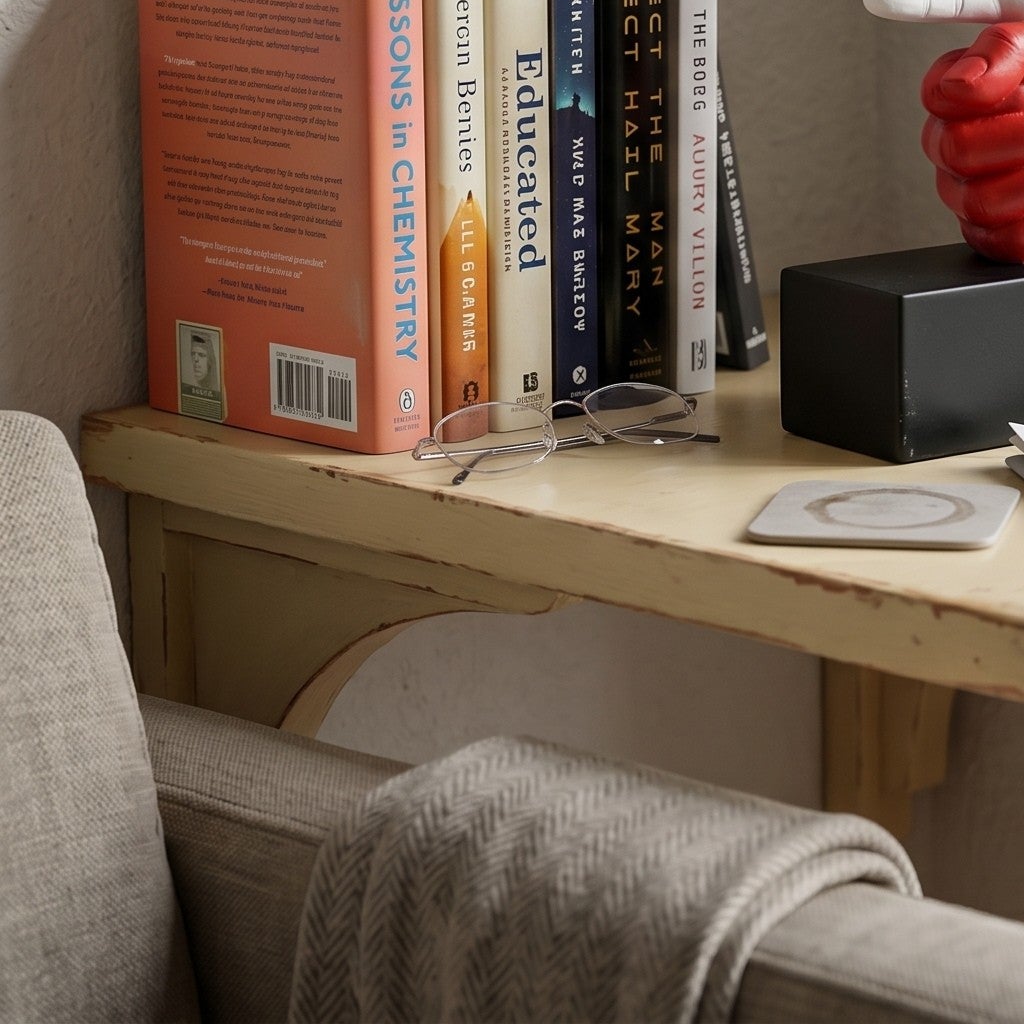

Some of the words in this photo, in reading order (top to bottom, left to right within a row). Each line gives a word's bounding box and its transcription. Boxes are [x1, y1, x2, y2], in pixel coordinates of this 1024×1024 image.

[693, 9, 707, 48] THE
[392, 122, 413, 149] in
[515, 47, 546, 272] Educated
[624, 91, 640, 192] HAIL
[650, 88, 663, 163] THE
[391, 160, 418, 362] CHEMISTRY
[625, 214, 641, 316] MARY
[651, 211, 664, 286] MAN
[692, 228, 706, 310] VILLON
